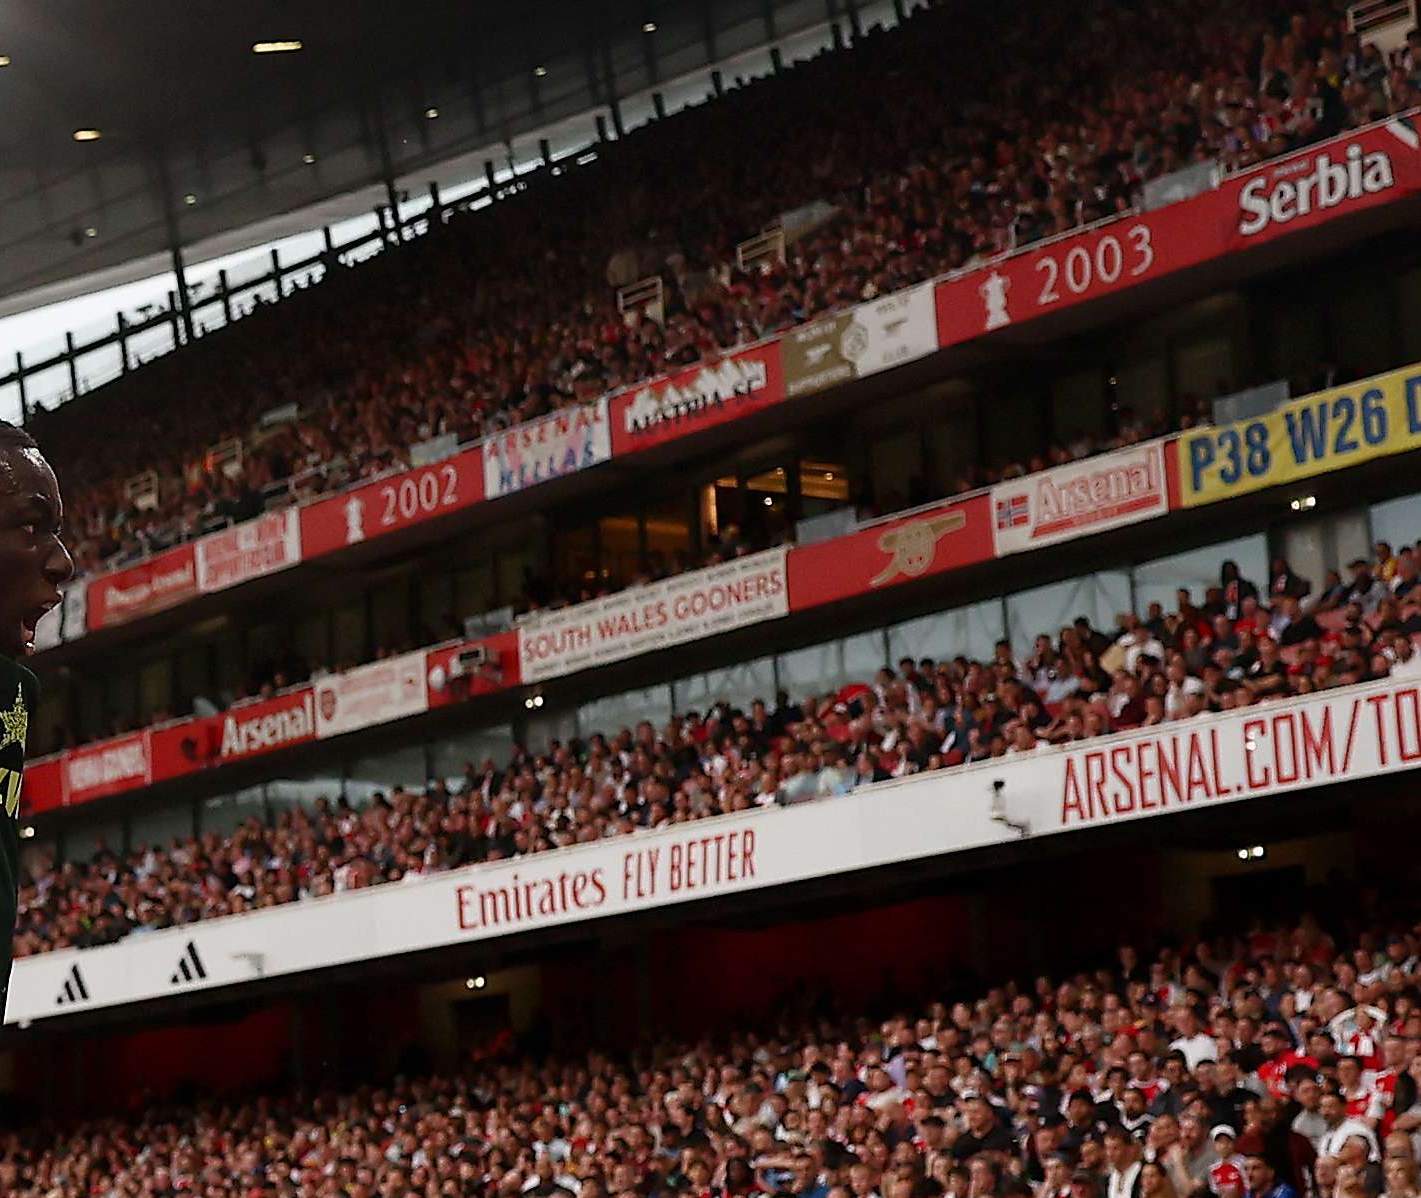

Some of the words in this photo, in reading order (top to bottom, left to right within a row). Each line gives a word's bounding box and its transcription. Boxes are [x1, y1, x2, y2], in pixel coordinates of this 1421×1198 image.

[1238, 143, 1395, 236] Serbia
[1035, 224, 1155, 305] 2003
[1189, 422, 1272, 493] P38
[1285, 389, 1389, 465] W26
[380, 465, 457, 527] 2002
[1037, 450, 1158, 522] Arsenal
[525, 622, 592, 664] SOUTH
[598, 600, 668, 641] WALES
[674, 566, 783, 620] GOONERS
[221, 695, 313, 758] Arsenal
[455, 867, 607, 931] Emirates
[623, 847, 659, 901] FLY
[669, 829, 756, 892] BETTER
